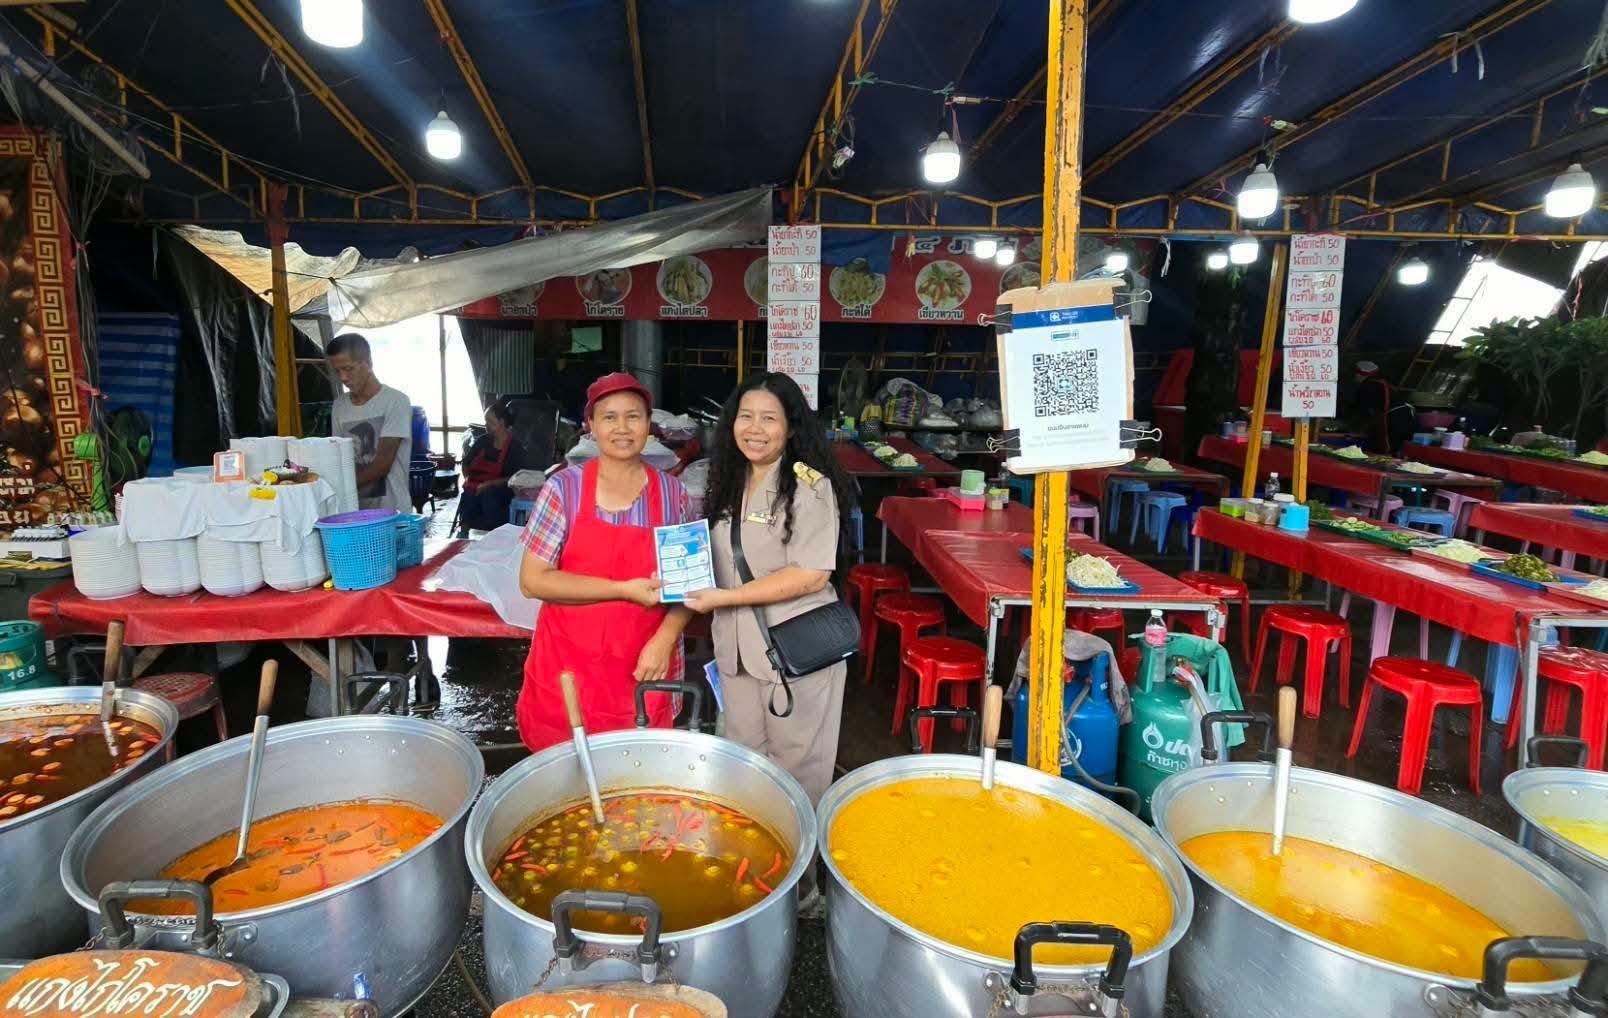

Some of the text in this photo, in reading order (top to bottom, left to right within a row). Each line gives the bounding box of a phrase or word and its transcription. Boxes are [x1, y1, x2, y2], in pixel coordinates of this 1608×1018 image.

[804, 230, 817, 240] 50
[1327, 238, 1340, 249] 50
[804, 245, 817, 256] 50
[1327, 254, 1340, 265] 50
[802, 281, 815, 293] 50
[1320, 309, 1333, 324] 60
[1322, 327, 1334, 336] 50
[802, 342, 814, 351] 50
[1321, 349, 1334, 359] 50
[1320, 363, 1332, 374] 50
[1302, 400, 1315, 410] 50
[7, 664, 37, 681] 16.8
